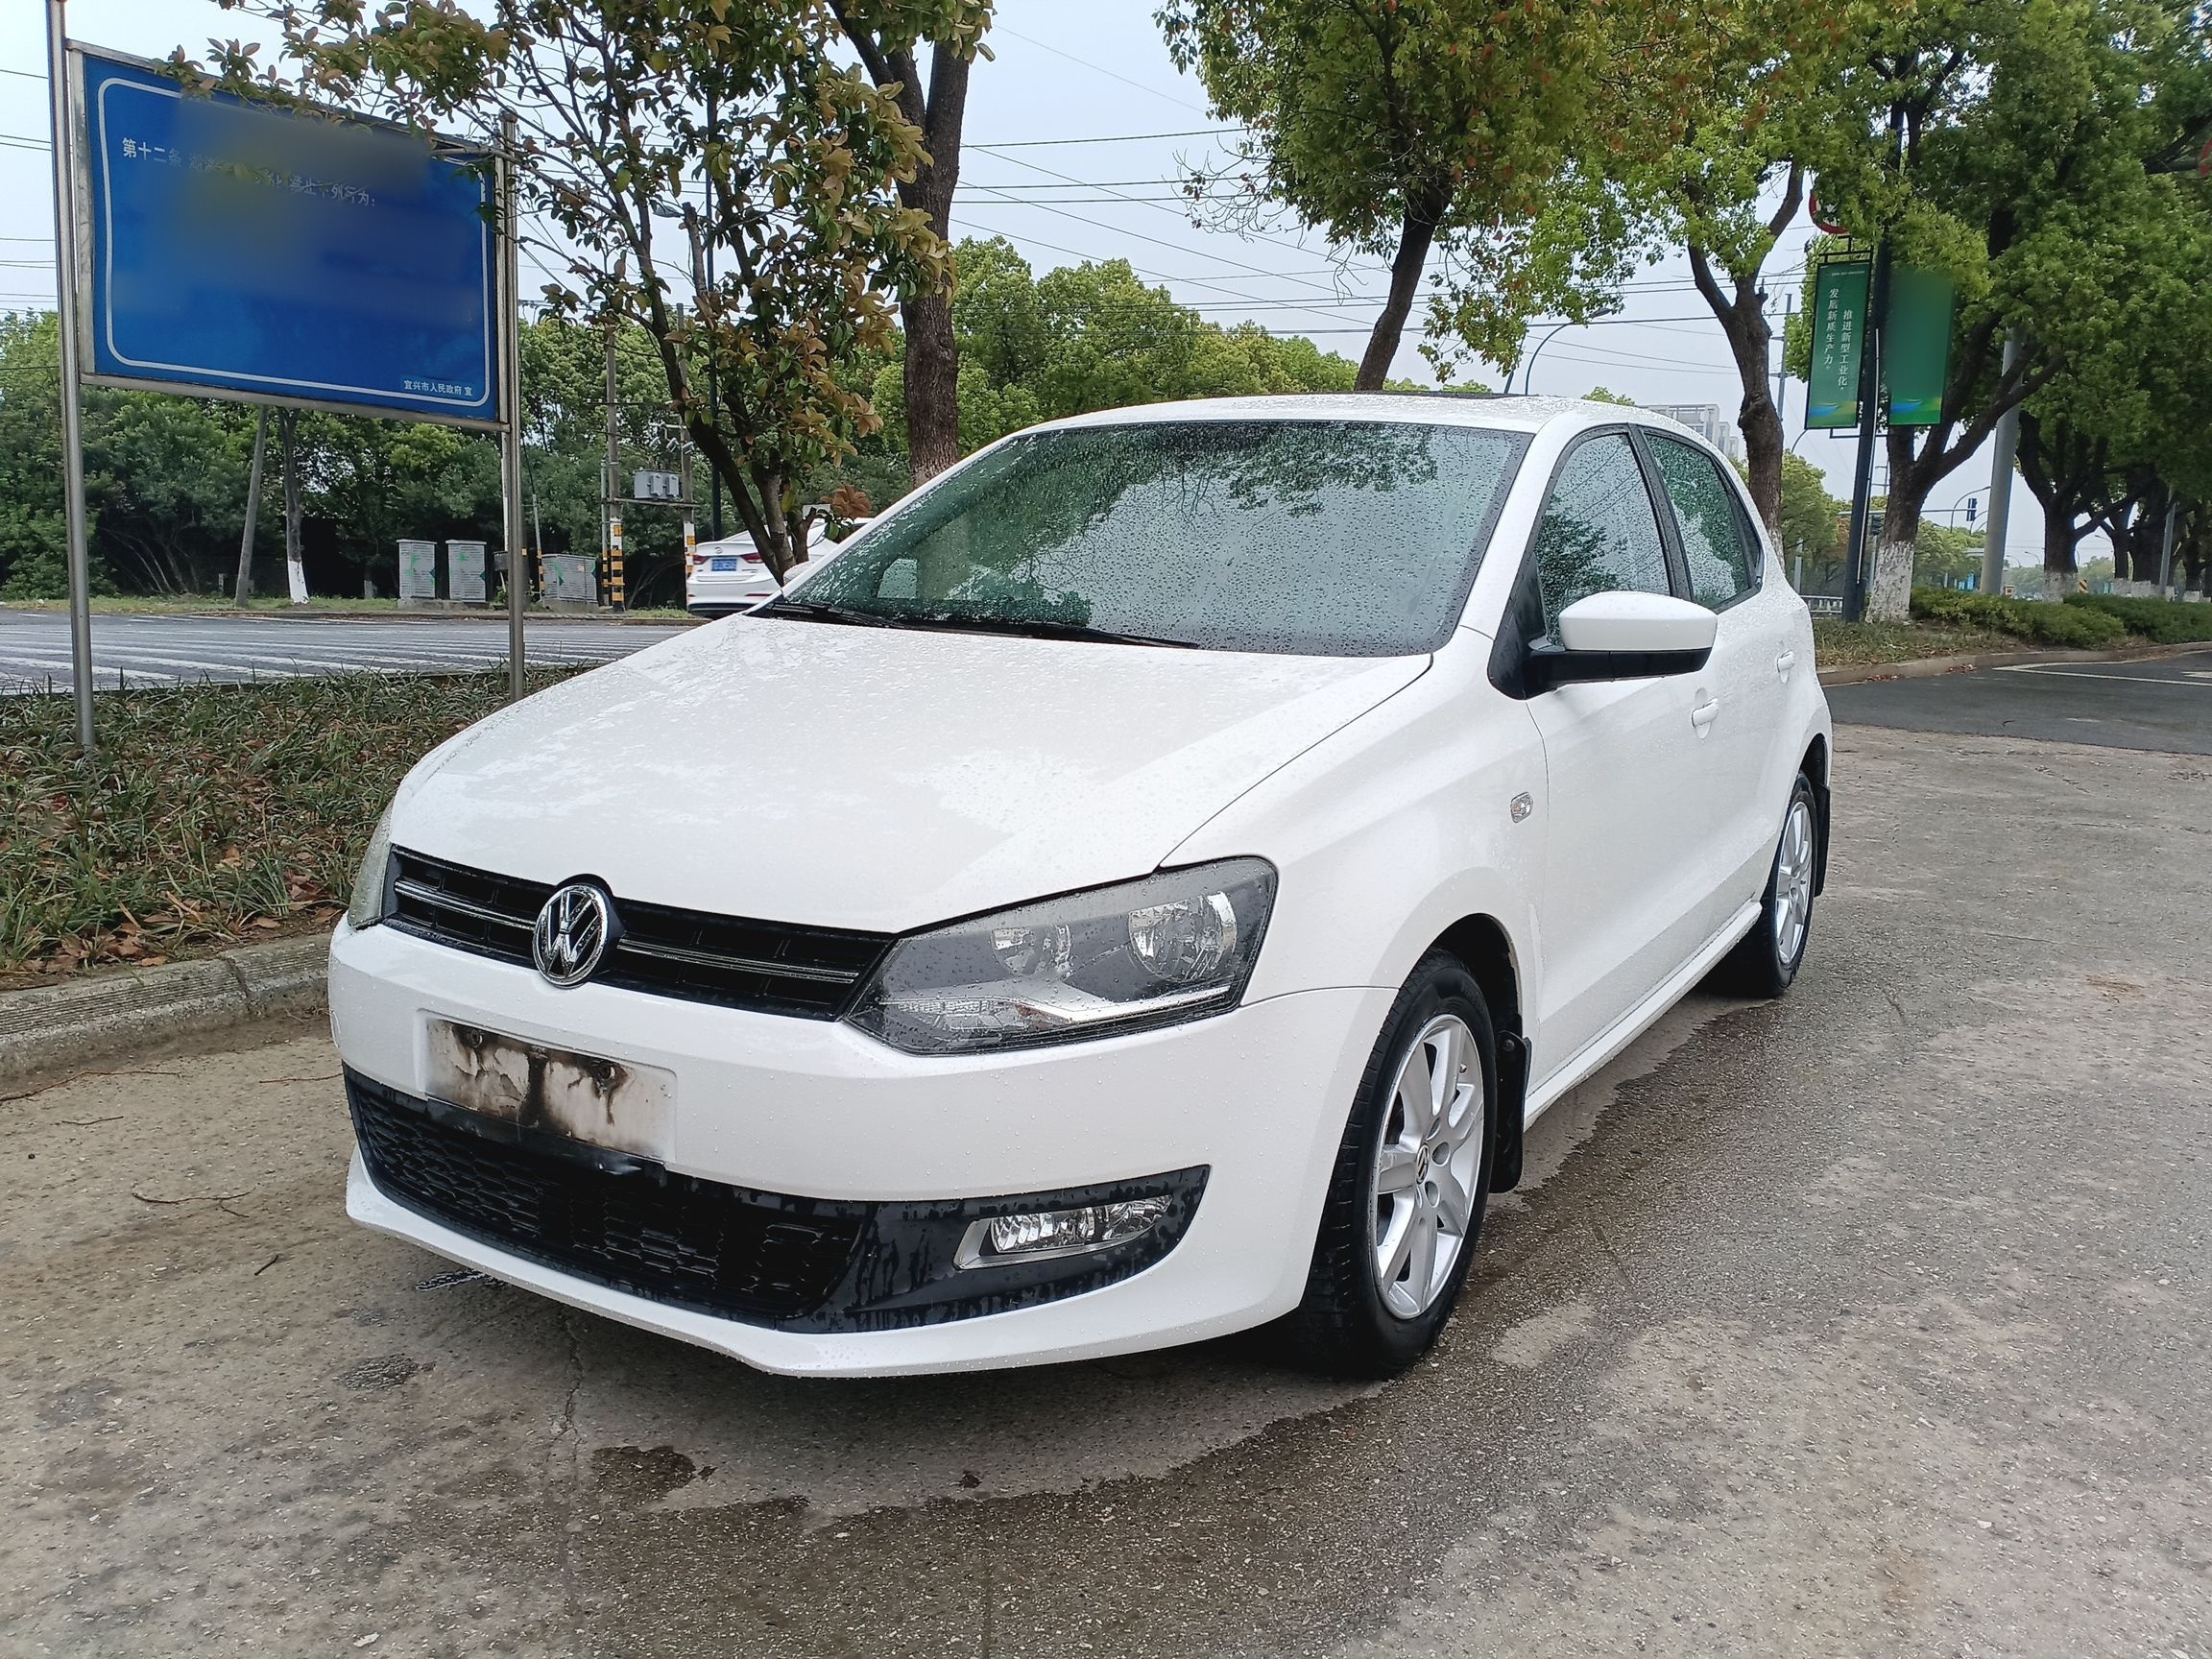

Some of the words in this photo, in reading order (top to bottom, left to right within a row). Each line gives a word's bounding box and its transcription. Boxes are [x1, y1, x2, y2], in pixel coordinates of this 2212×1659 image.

[403, 379, 462, 395] 宜兴市人民政府
